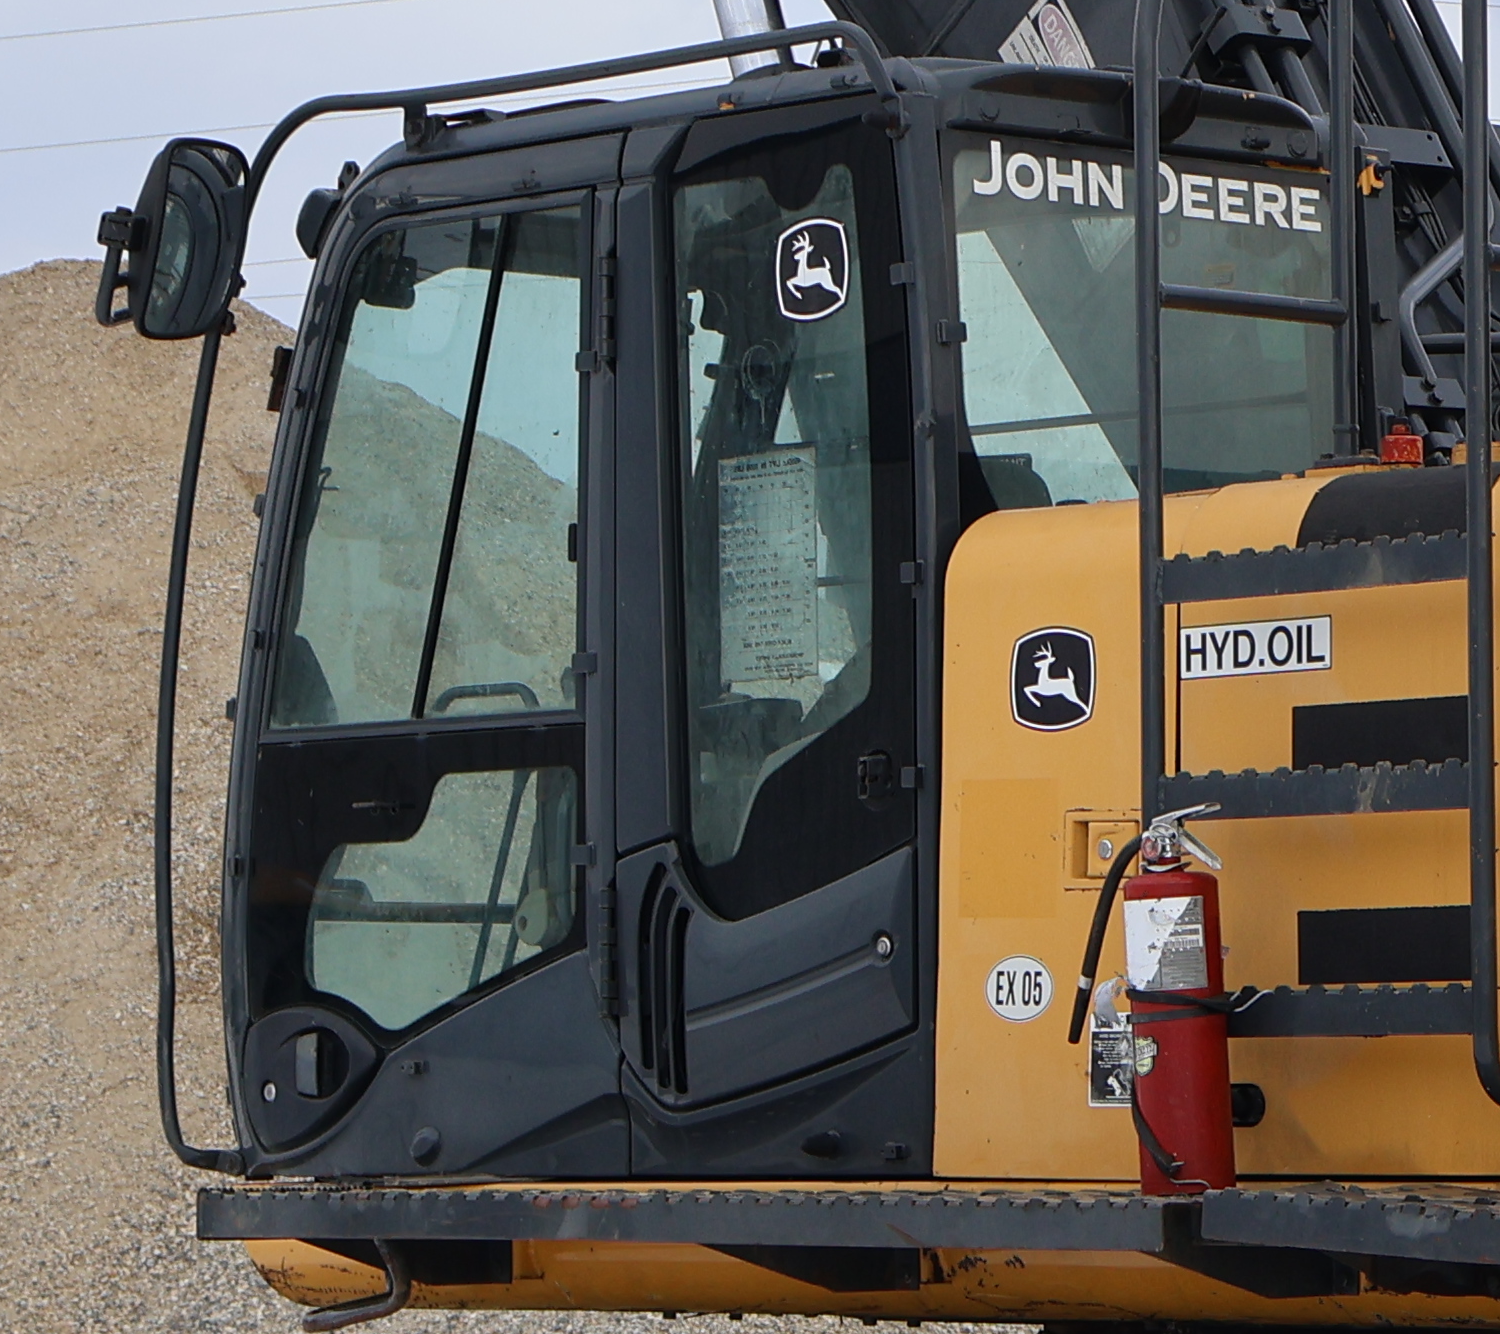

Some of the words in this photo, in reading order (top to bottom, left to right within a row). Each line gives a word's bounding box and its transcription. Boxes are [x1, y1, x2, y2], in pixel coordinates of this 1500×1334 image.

[1044, 14, 1078, 67] DANG
[973, 140, 1124, 210] JOHN
[1185, 624, 1326, 673] HYD.OIL
[995, 970, 1018, 1006] EX
[1021, 970, 1043, 1007] 05
